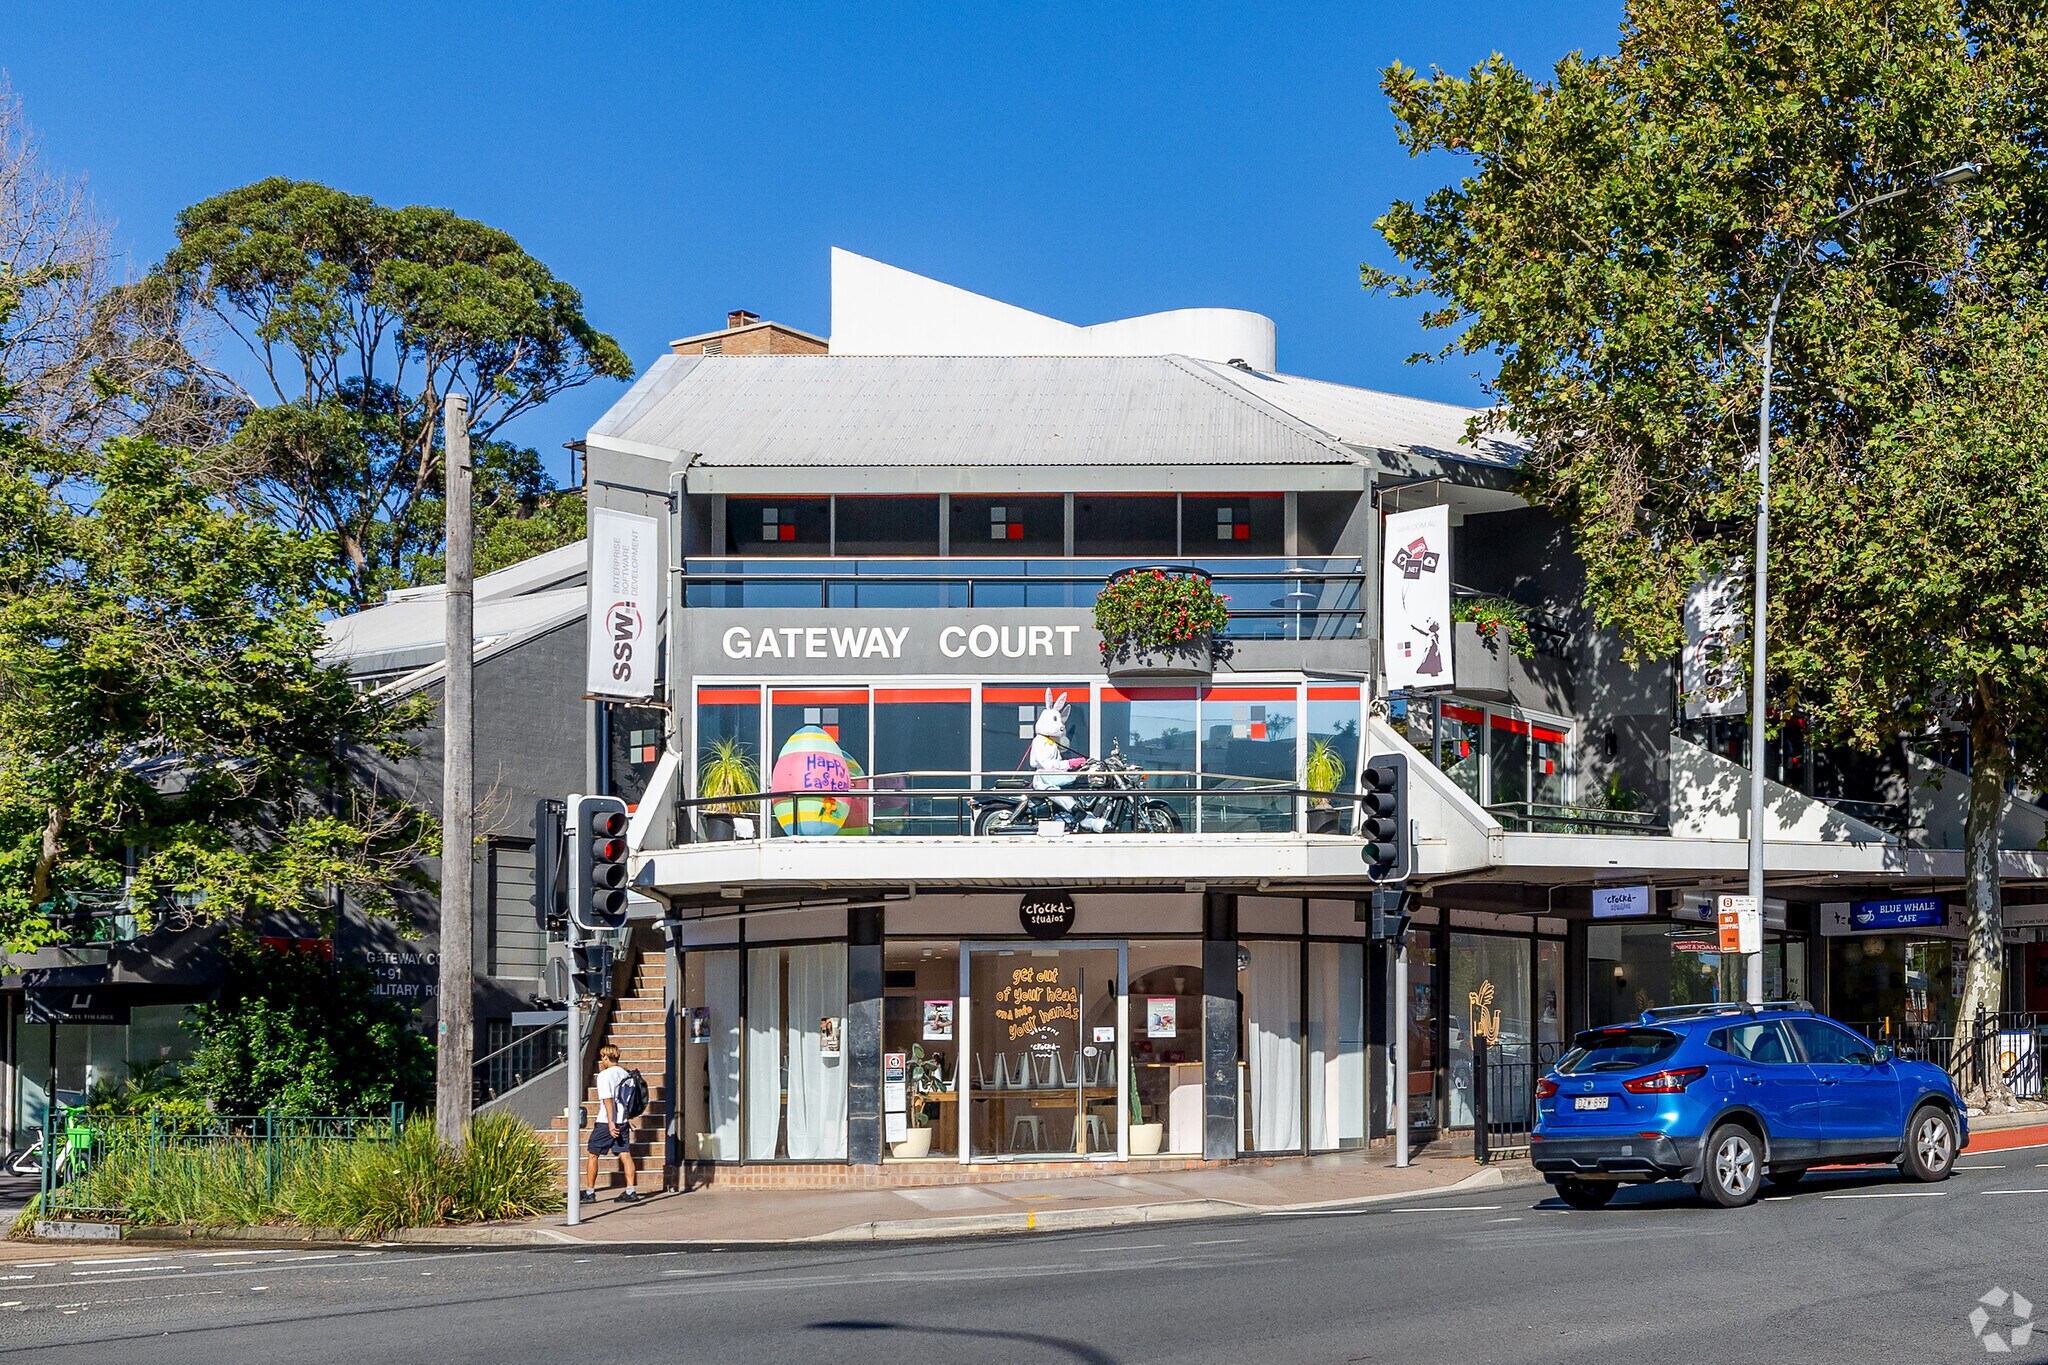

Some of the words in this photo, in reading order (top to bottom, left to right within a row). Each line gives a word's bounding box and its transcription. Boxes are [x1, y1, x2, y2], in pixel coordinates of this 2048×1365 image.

[612, 538, 621, 594] ENTERPRISE
[621, 545, 630, 595] SOFTWARE
[631, 530, 639, 596] DEVELOPMENT
[612, 612, 634, 682] SSW
[722, 626, 910, 659] GATEWAY
[939, 624, 1080, 659] COURT
[806, 754, 846, 778] Happy
[1879, 903, 1901, 914] BLUE
[1903, 901, 1935, 912] WHALE
[1031, 915, 1064, 924] studios
[1724, 915, 1734, 923] NO
[1897, 914, 1917, 923] CAFE
[1012, 967, 1034, 985] get
[1036, 967, 1058, 983] out
[373, 983, 420, 996] ILITARY
[996, 986, 1012, 1002] of
[1013, 986, 1044, 1004] your
[1046, 986, 1078, 1002] head
[995, 1009, 1013, 1020] and
[1008, 1015, 1037, 1040] your
[1038, 1003, 1080, 1024] hands
